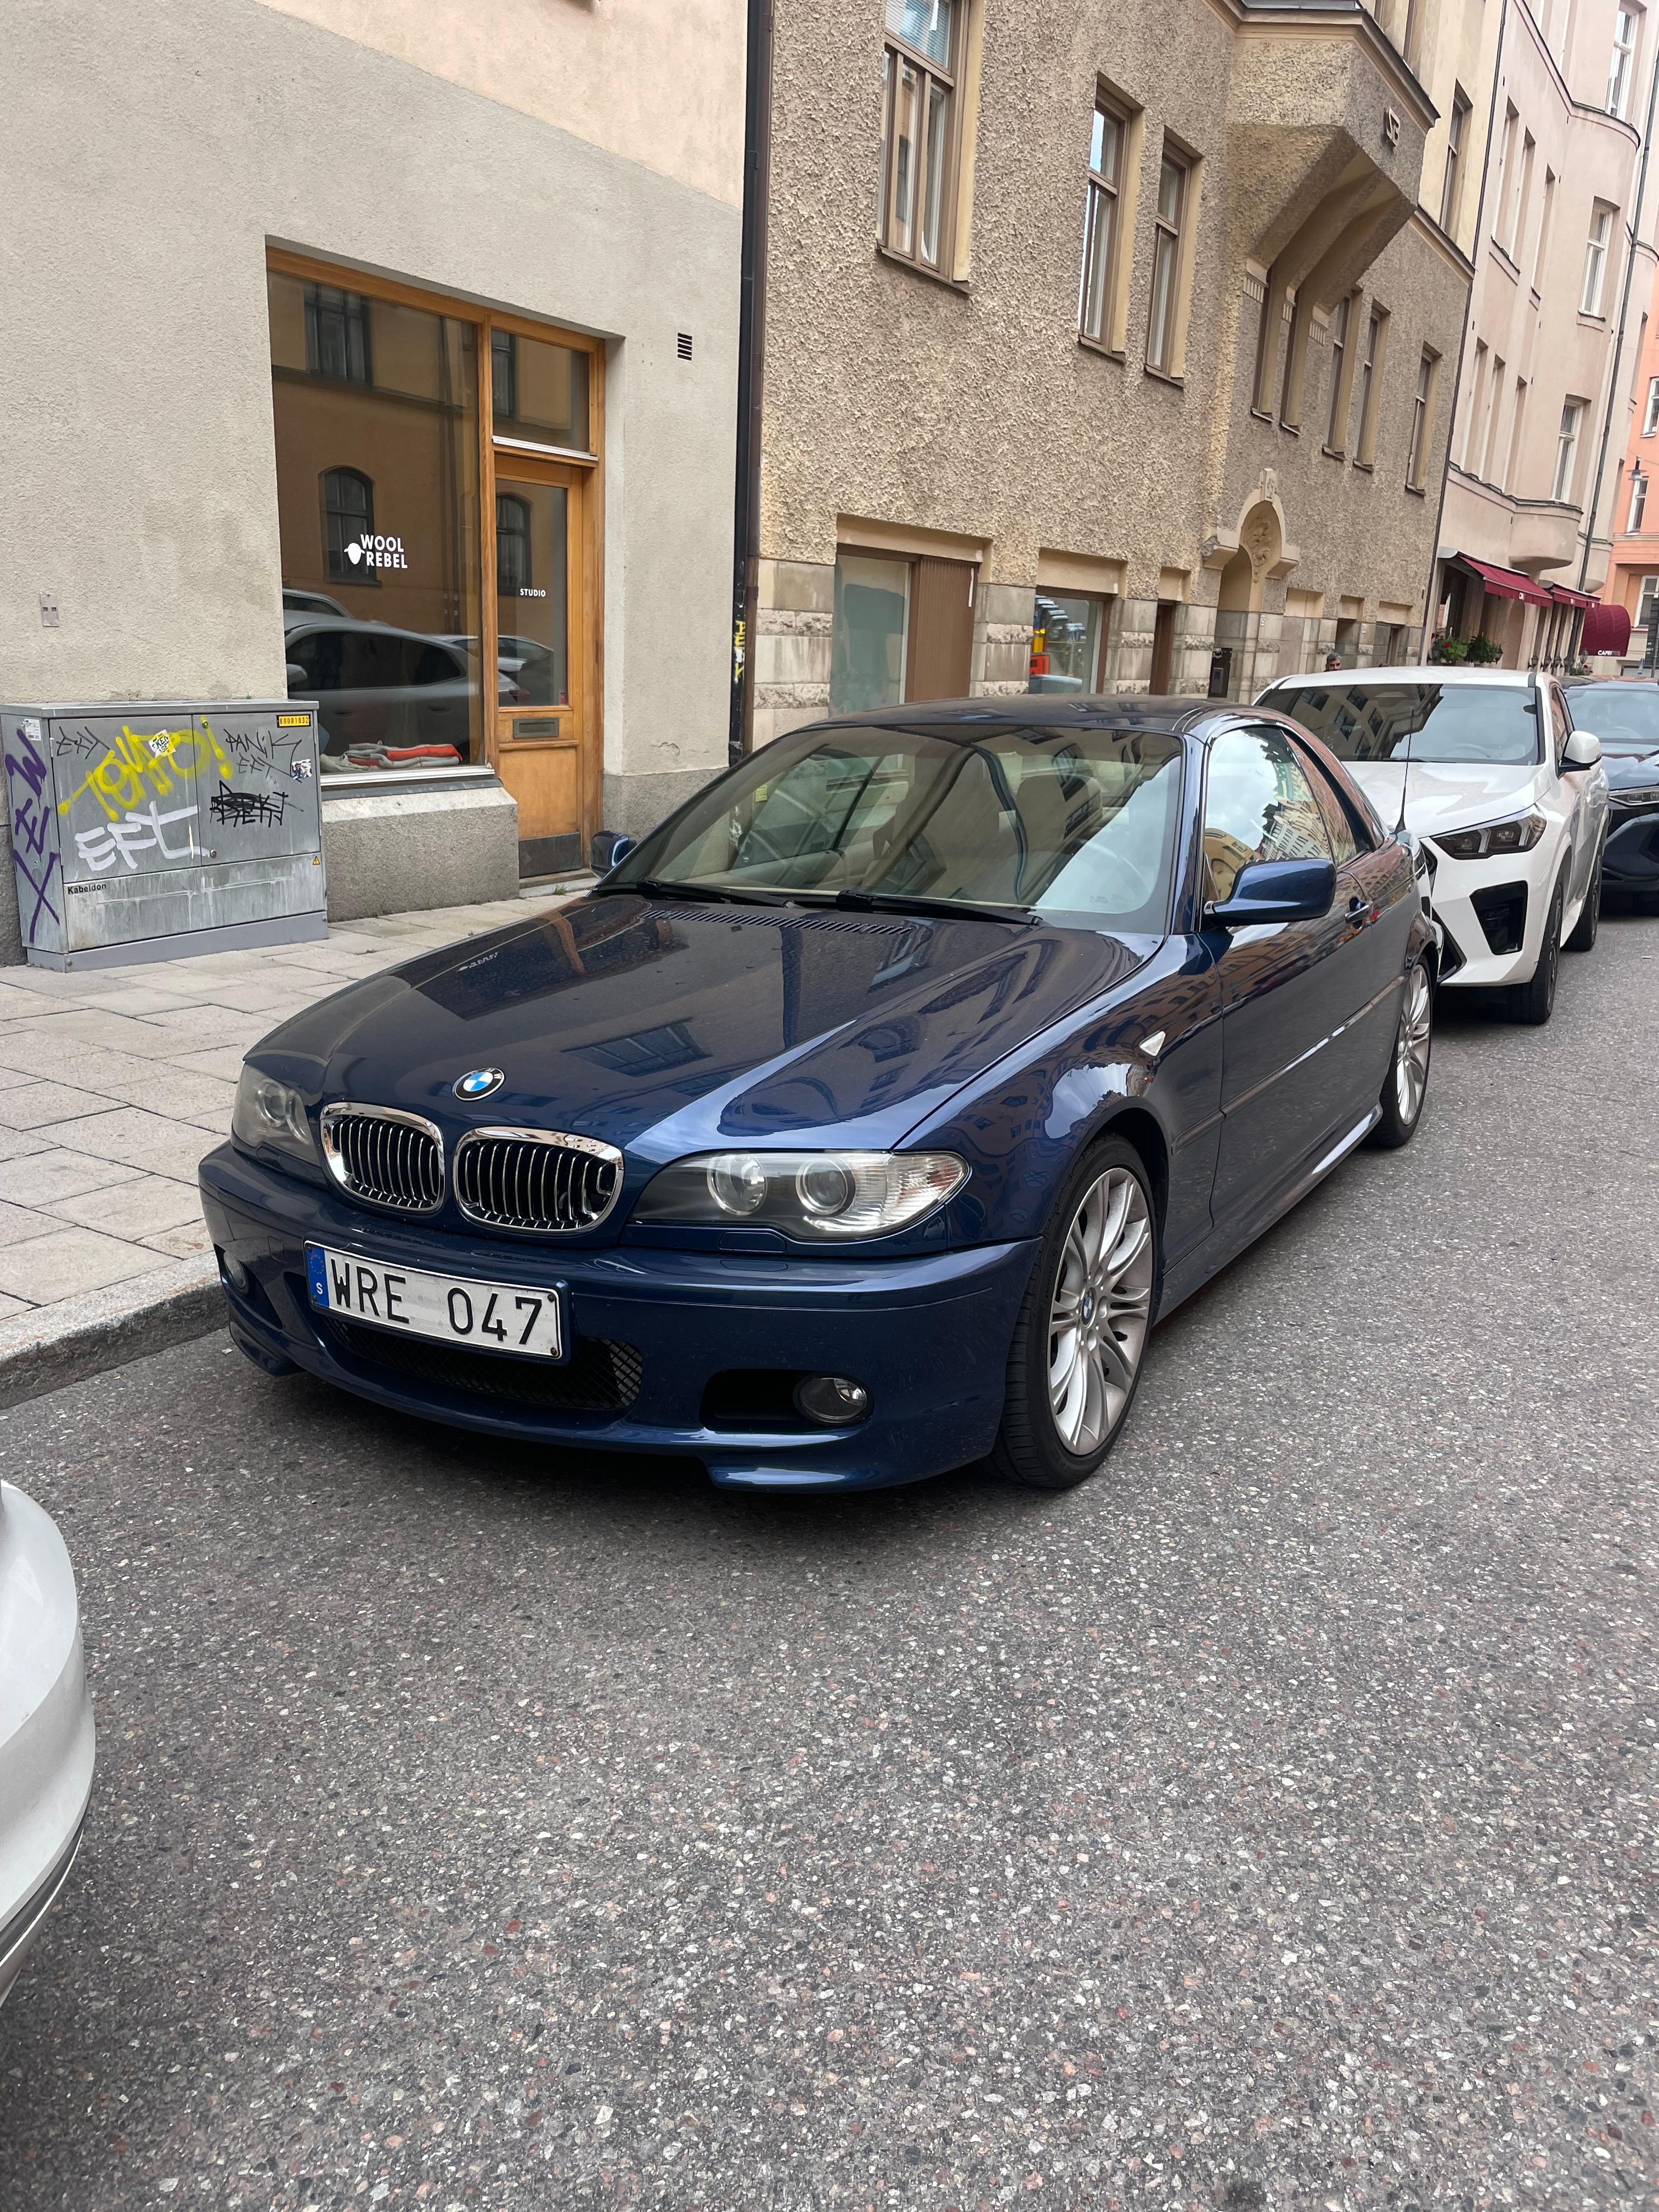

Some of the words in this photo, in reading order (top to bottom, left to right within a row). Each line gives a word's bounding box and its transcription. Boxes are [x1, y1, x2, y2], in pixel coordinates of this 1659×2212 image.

[360, 534, 404, 552] WOOL
[366, 551, 408, 569] REBEL
[520, 588, 546, 597] STUDIO
[67, 883, 106, 895] Kabeldon
[315, 1282, 323, 1295] S
[330, 1257, 410, 1324] WRE
[447, 1286, 543, 1345] 047
